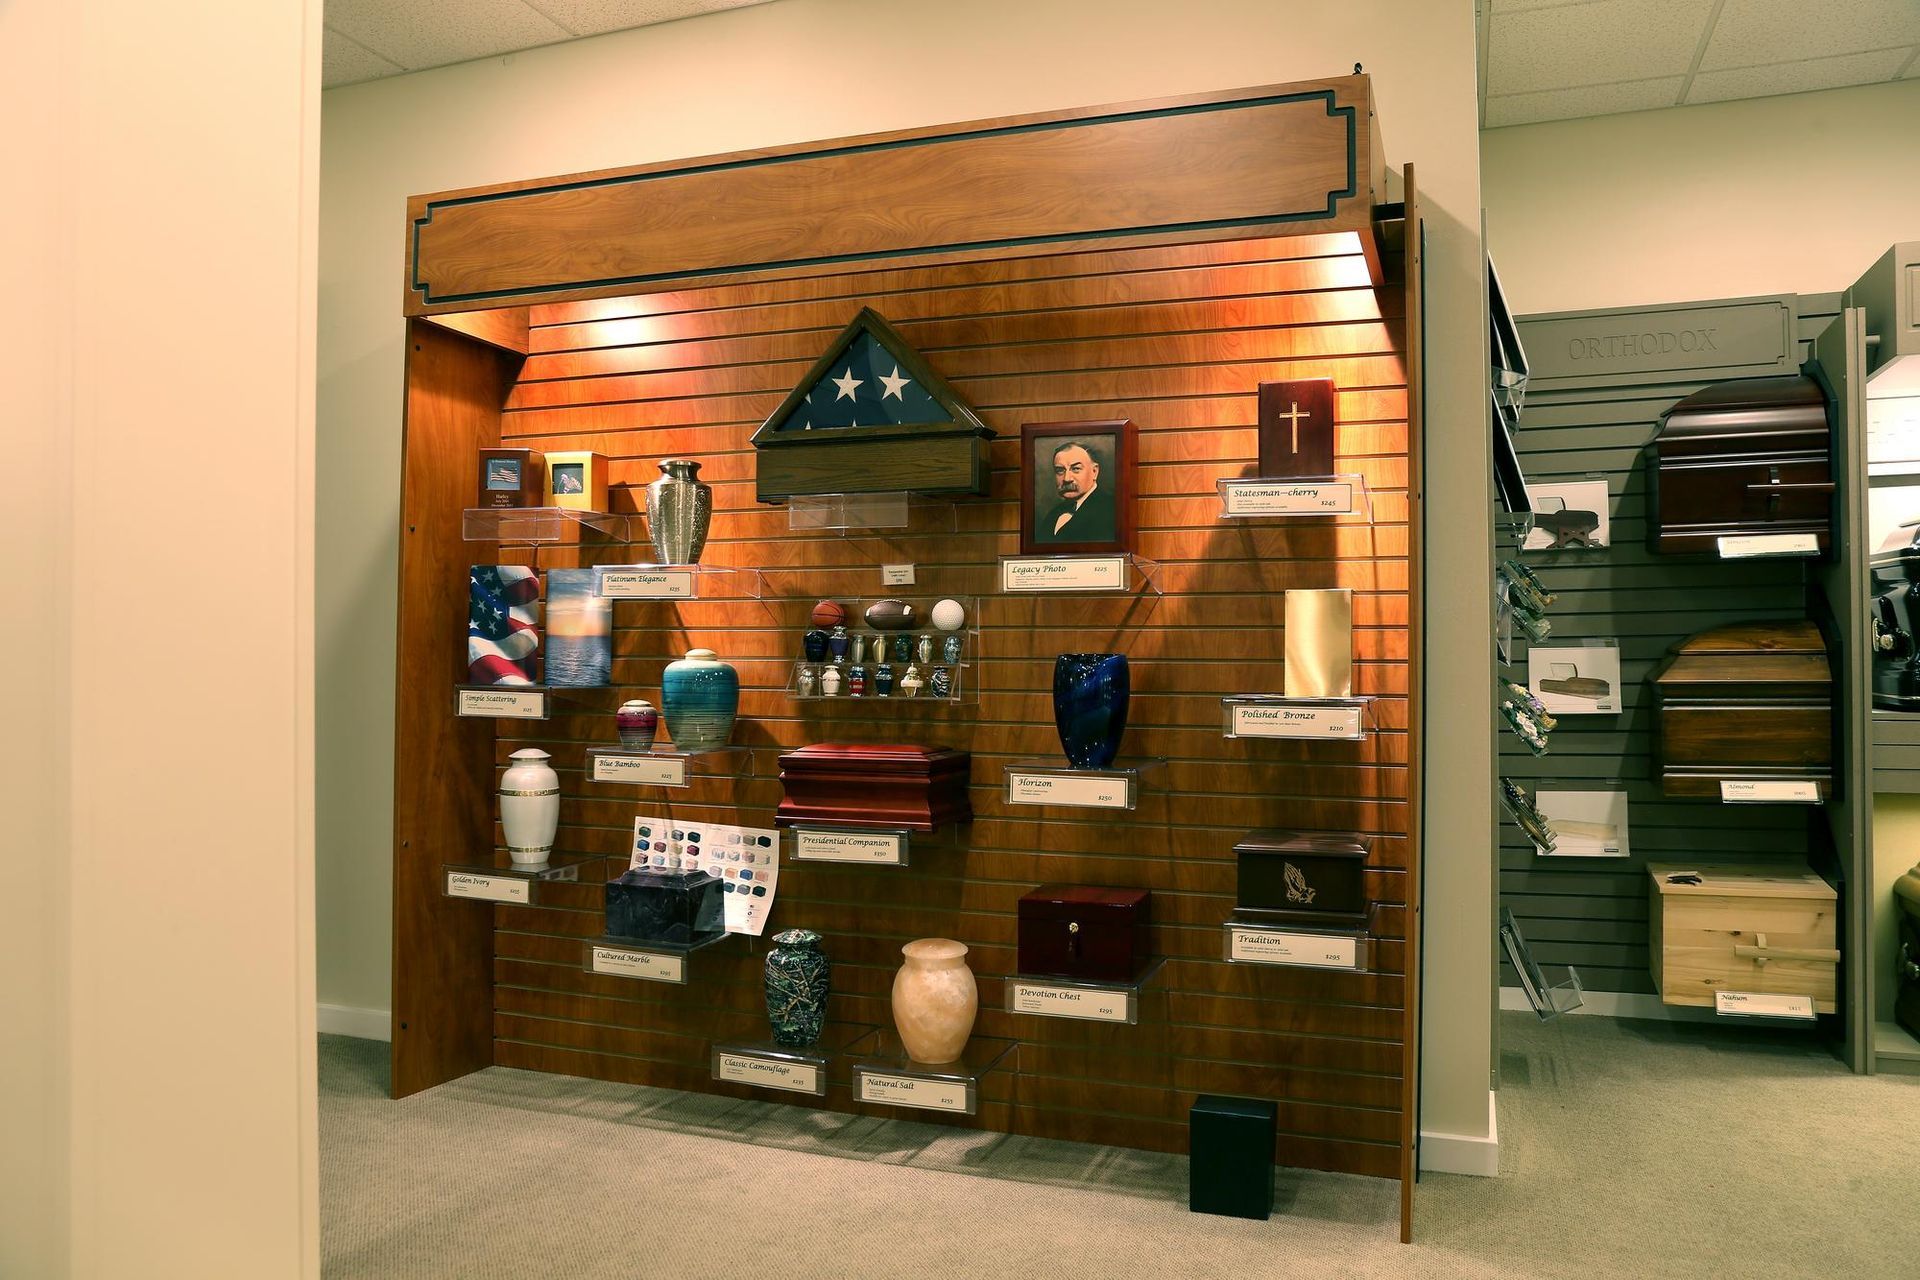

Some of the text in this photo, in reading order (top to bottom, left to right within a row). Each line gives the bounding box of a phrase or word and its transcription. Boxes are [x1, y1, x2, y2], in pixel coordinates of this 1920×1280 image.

[1569, 328, 1718, 360] ORTHODOX
[1012, 564, 1067, 575] Legacy Photo
[606, 574, 668, 585] Platinum Elegance
[464, 694, 517, 704] Simple Scattering
[1241, 709, 1316, 720] Polished Bronze
[598, 759, 641, 768] Blue Bamboo
[1018, 777, 1053, 787] Horizon
[802, 836, 891, 848] Presidential Companion
[451, 875, 490, 887] Golden Ivory
[1238, 934, 1281, 945] Tradition
[597, 951, 651, 964] Cultured Marble
[1019, 988, 1081, 1001] Devotion Chest
[1099, 1007, 1113, 1015] $295
[724, 1058, 748, 1068] Classic
[748, 1061, 791, 1075] Camouflage
[867, 1078, 915, 1090] Natural Salt
